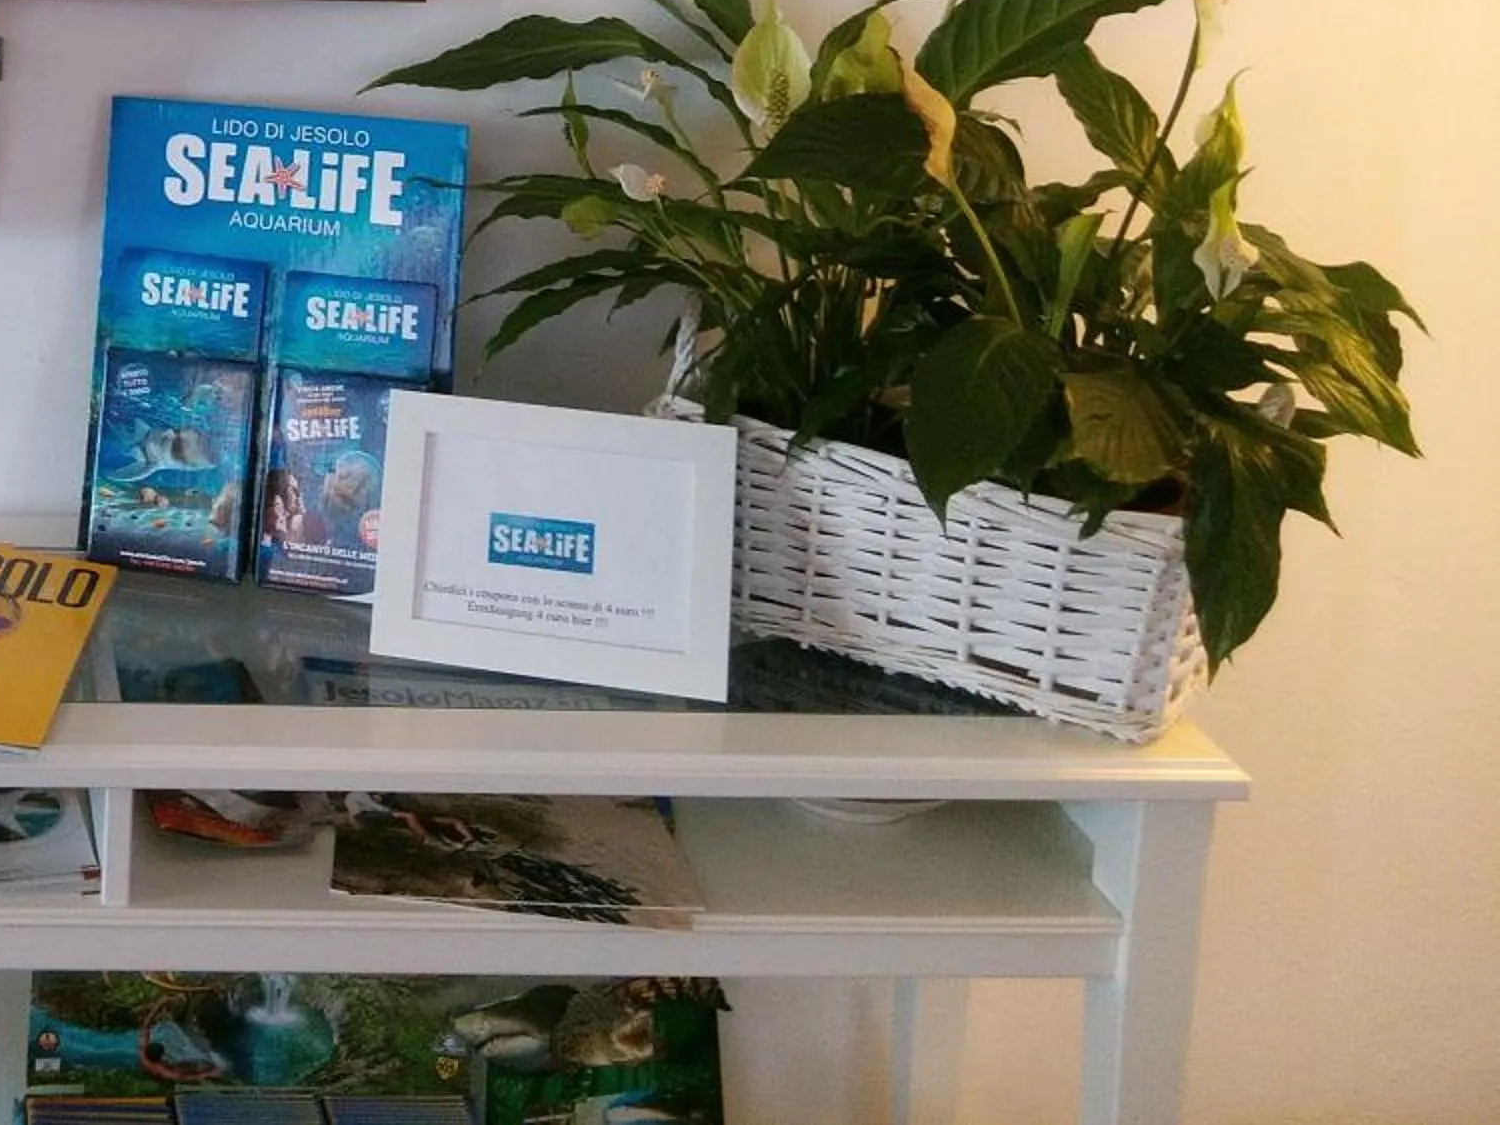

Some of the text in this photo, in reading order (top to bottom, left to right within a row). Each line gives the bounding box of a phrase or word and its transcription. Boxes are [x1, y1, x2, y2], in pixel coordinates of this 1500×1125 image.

[211, 117, 370, 148] LIDO DI JESOLO
[229, 210, 341, 237] AQUARIUM
[337, 332, 390, 345] AQUARIUM
[606, 604, 613, 613] 4
[536, 611, 543, 620] 4
